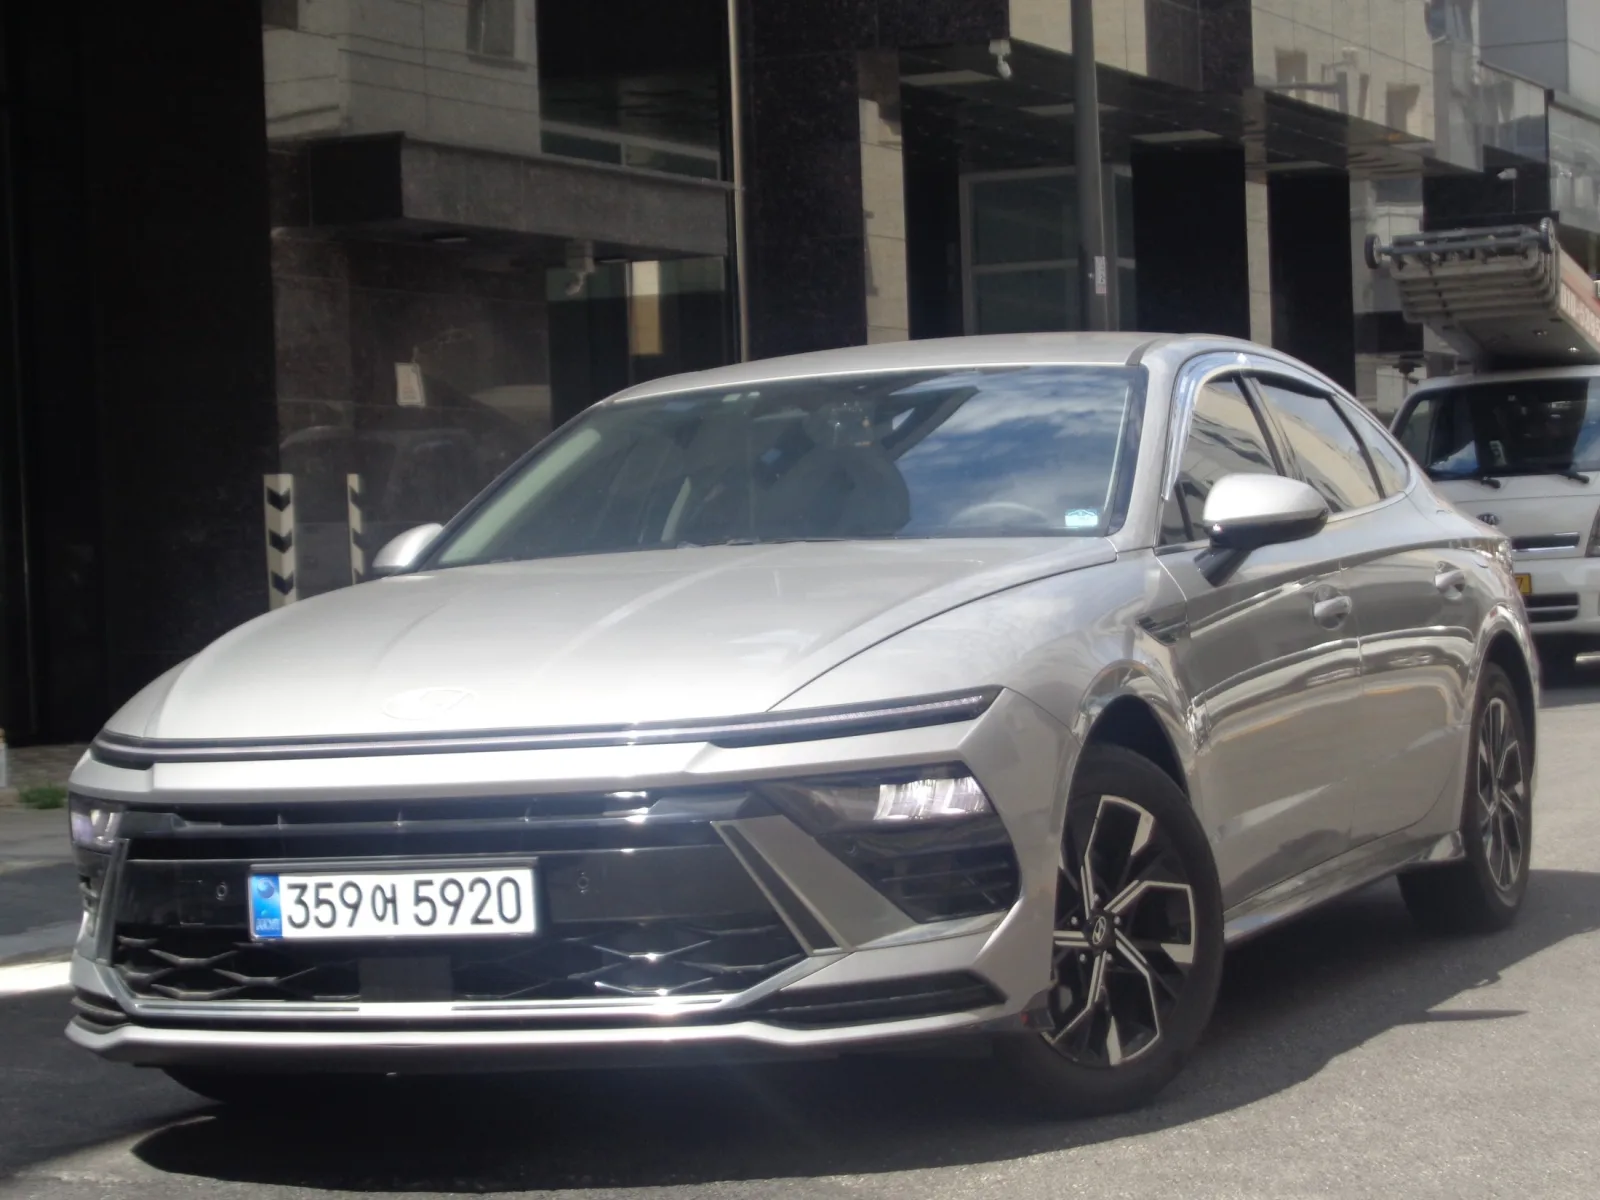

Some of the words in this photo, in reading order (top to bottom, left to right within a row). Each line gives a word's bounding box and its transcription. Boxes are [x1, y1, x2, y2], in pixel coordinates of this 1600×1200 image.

[286, 880, 363, 929] 359
[371, 883, 399, 926] 어
[413, 876, 522, 926] 5920
